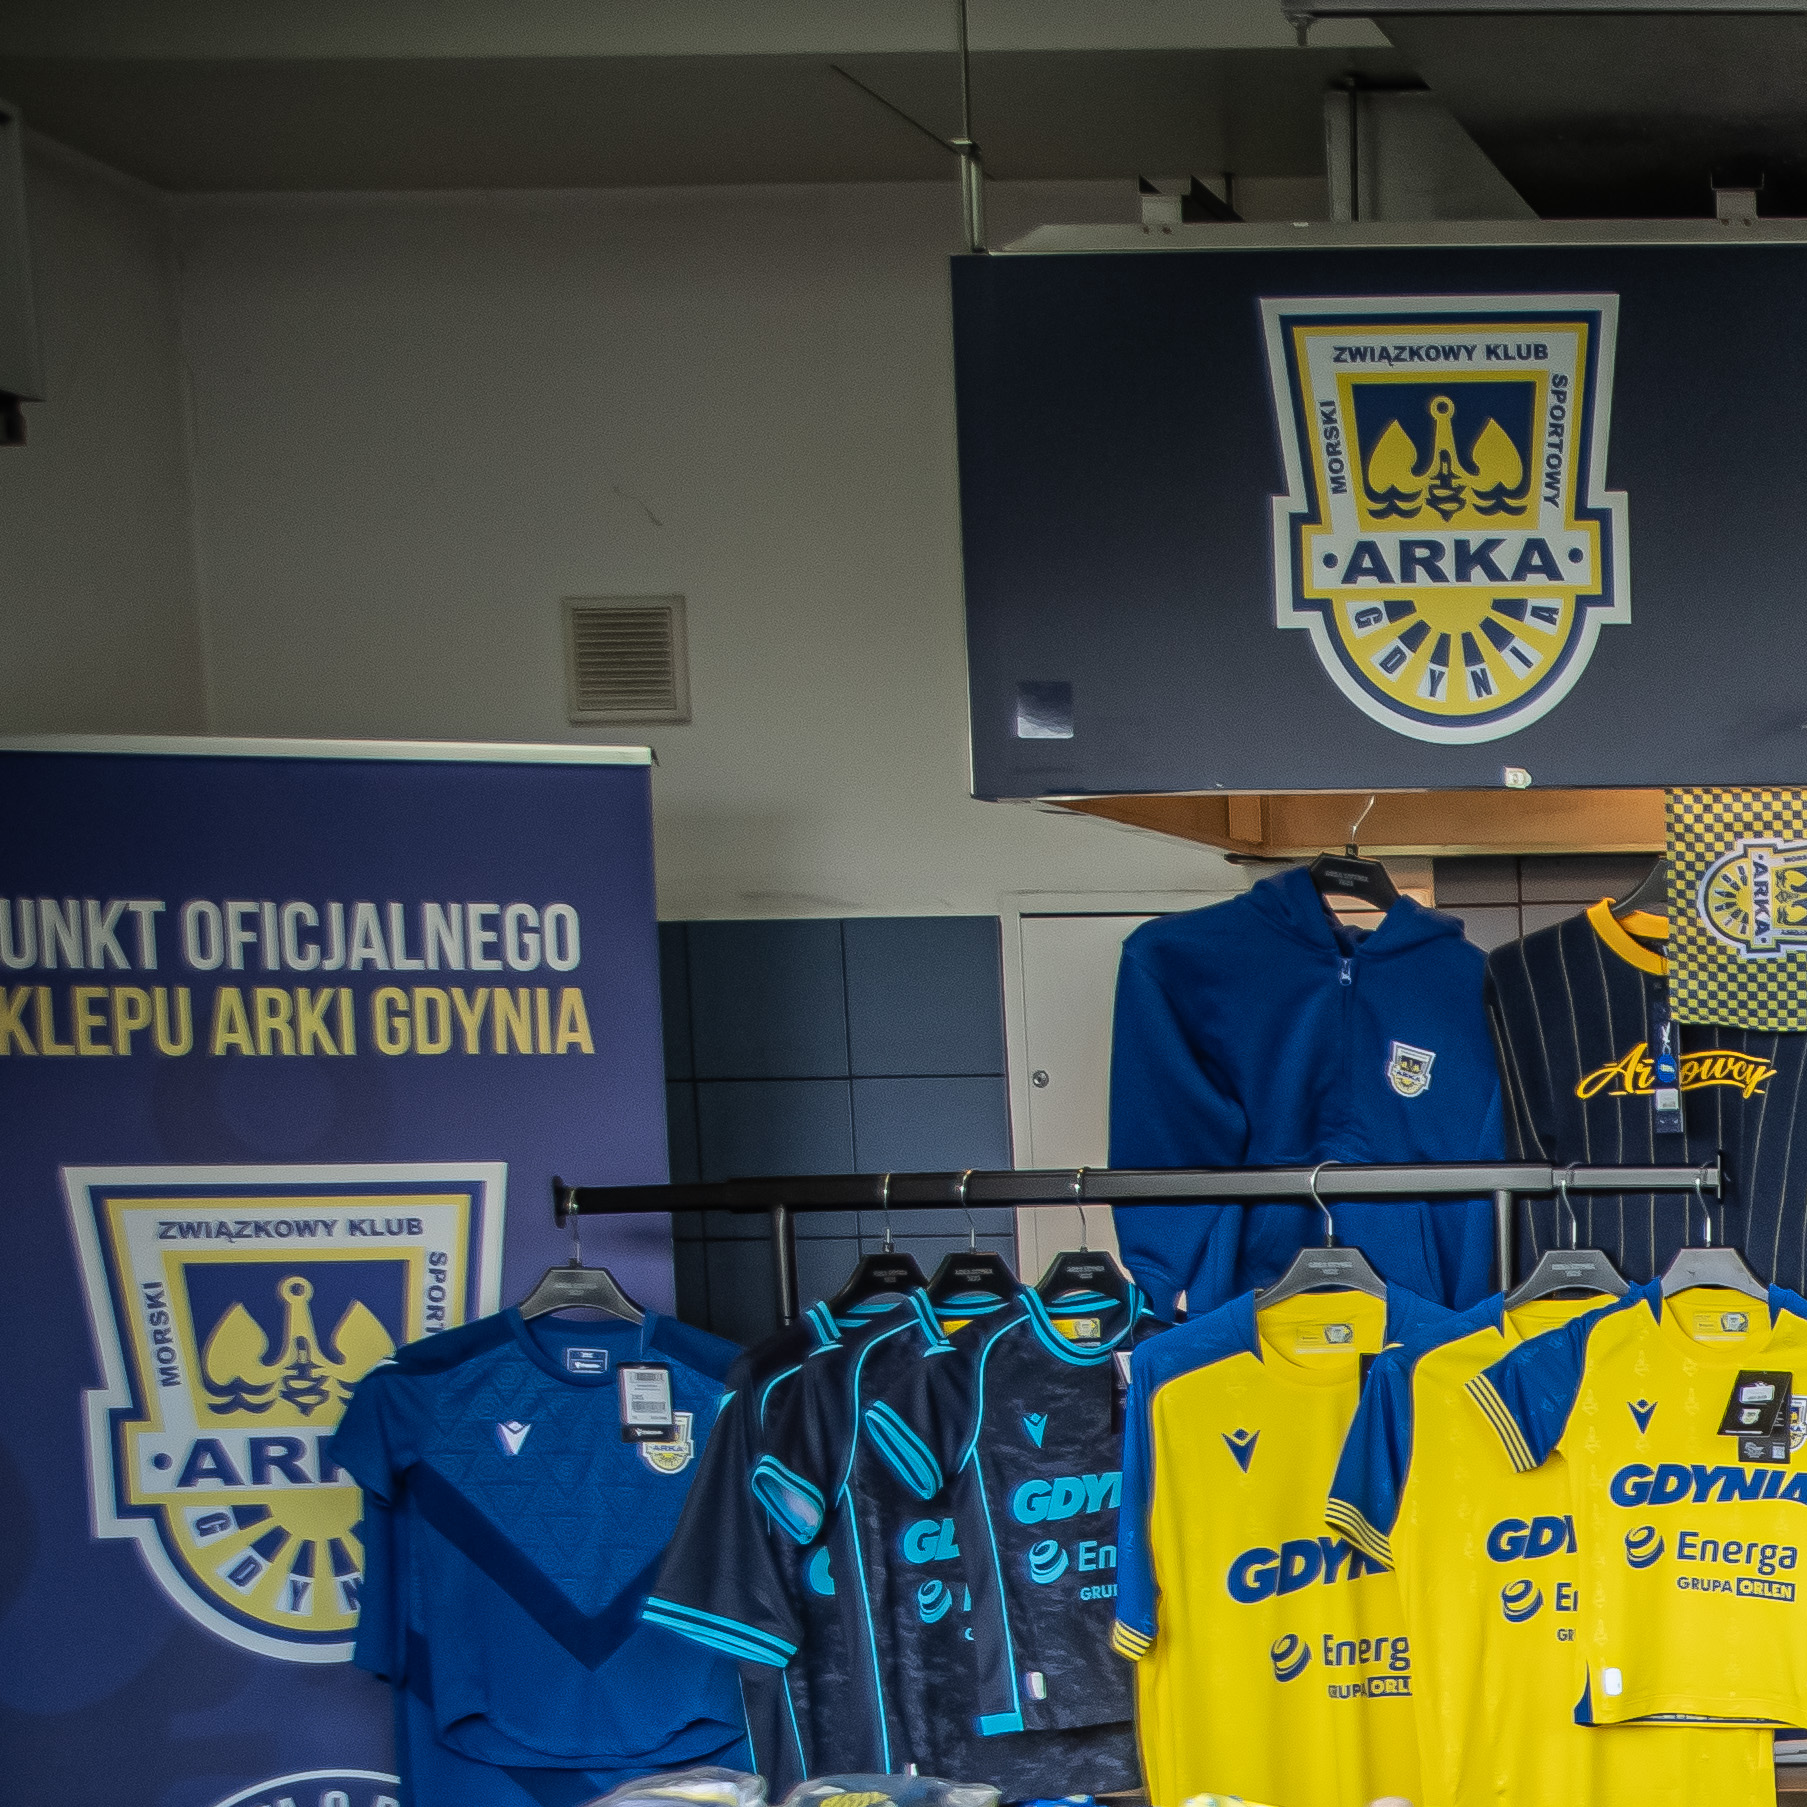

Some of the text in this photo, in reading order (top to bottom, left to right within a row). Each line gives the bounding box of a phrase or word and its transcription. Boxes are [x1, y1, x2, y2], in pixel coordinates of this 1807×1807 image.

[1333, 343, 1548, 366] ZWIĄZKOWY KLUB
[1318, 400, 1348, 495] MORSKI
[1544, 373, 1568, 509] SPORTOWY
[1341, 537, 1565, 585] ARKA
[1355, 605, 1559, 698] GDYNIA
[1752, 860, 1770, 938] ARKA
[0, 900, 581, 971] UNKT OFICJALNEGO
[0, 986, 595, 1056] KLEPU ARKI GDYNIA
[1577, 1043, 1776, 1100] Arowcy
[158, 1217, 424, 1244] ZWIĄZKOWY KLUB
[143, 1281, 181, 1387] MORSKI
[652, 1444, 684, 1453] ARKA
[1013, 1473, 1121, 1524] GDY
[1676, 1531, 1797, 1573] Energa
[1676, 1577, 1792, 1600] GRUPA ORLEN
